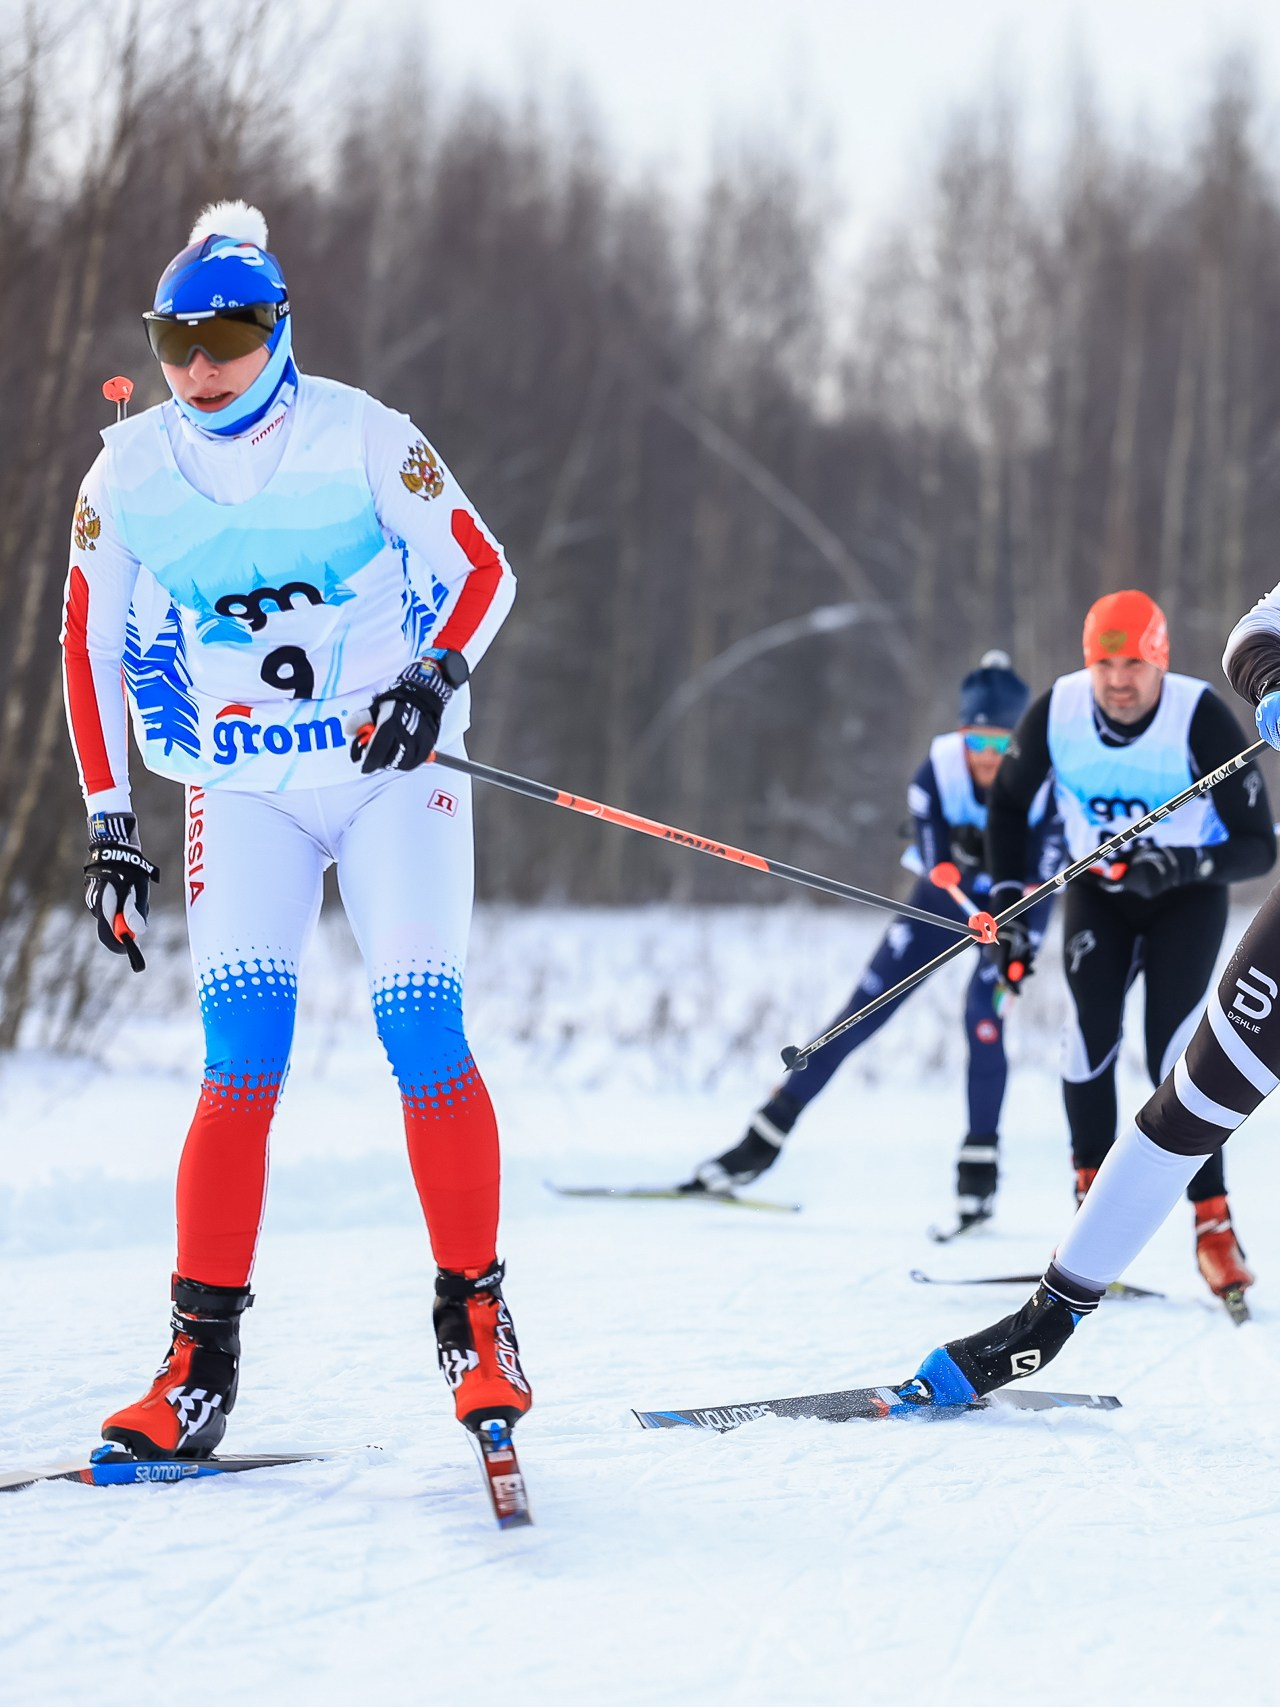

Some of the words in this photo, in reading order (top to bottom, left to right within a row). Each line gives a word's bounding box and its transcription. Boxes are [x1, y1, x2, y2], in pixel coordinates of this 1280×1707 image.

[214, 582, 325, 632] gm
[260, 645, 315, 700] 9
[213, 716, 346, 765] grom
[101, 849, 154, 874] ATOMIC
[188, 785, 206, 907] USSIA
